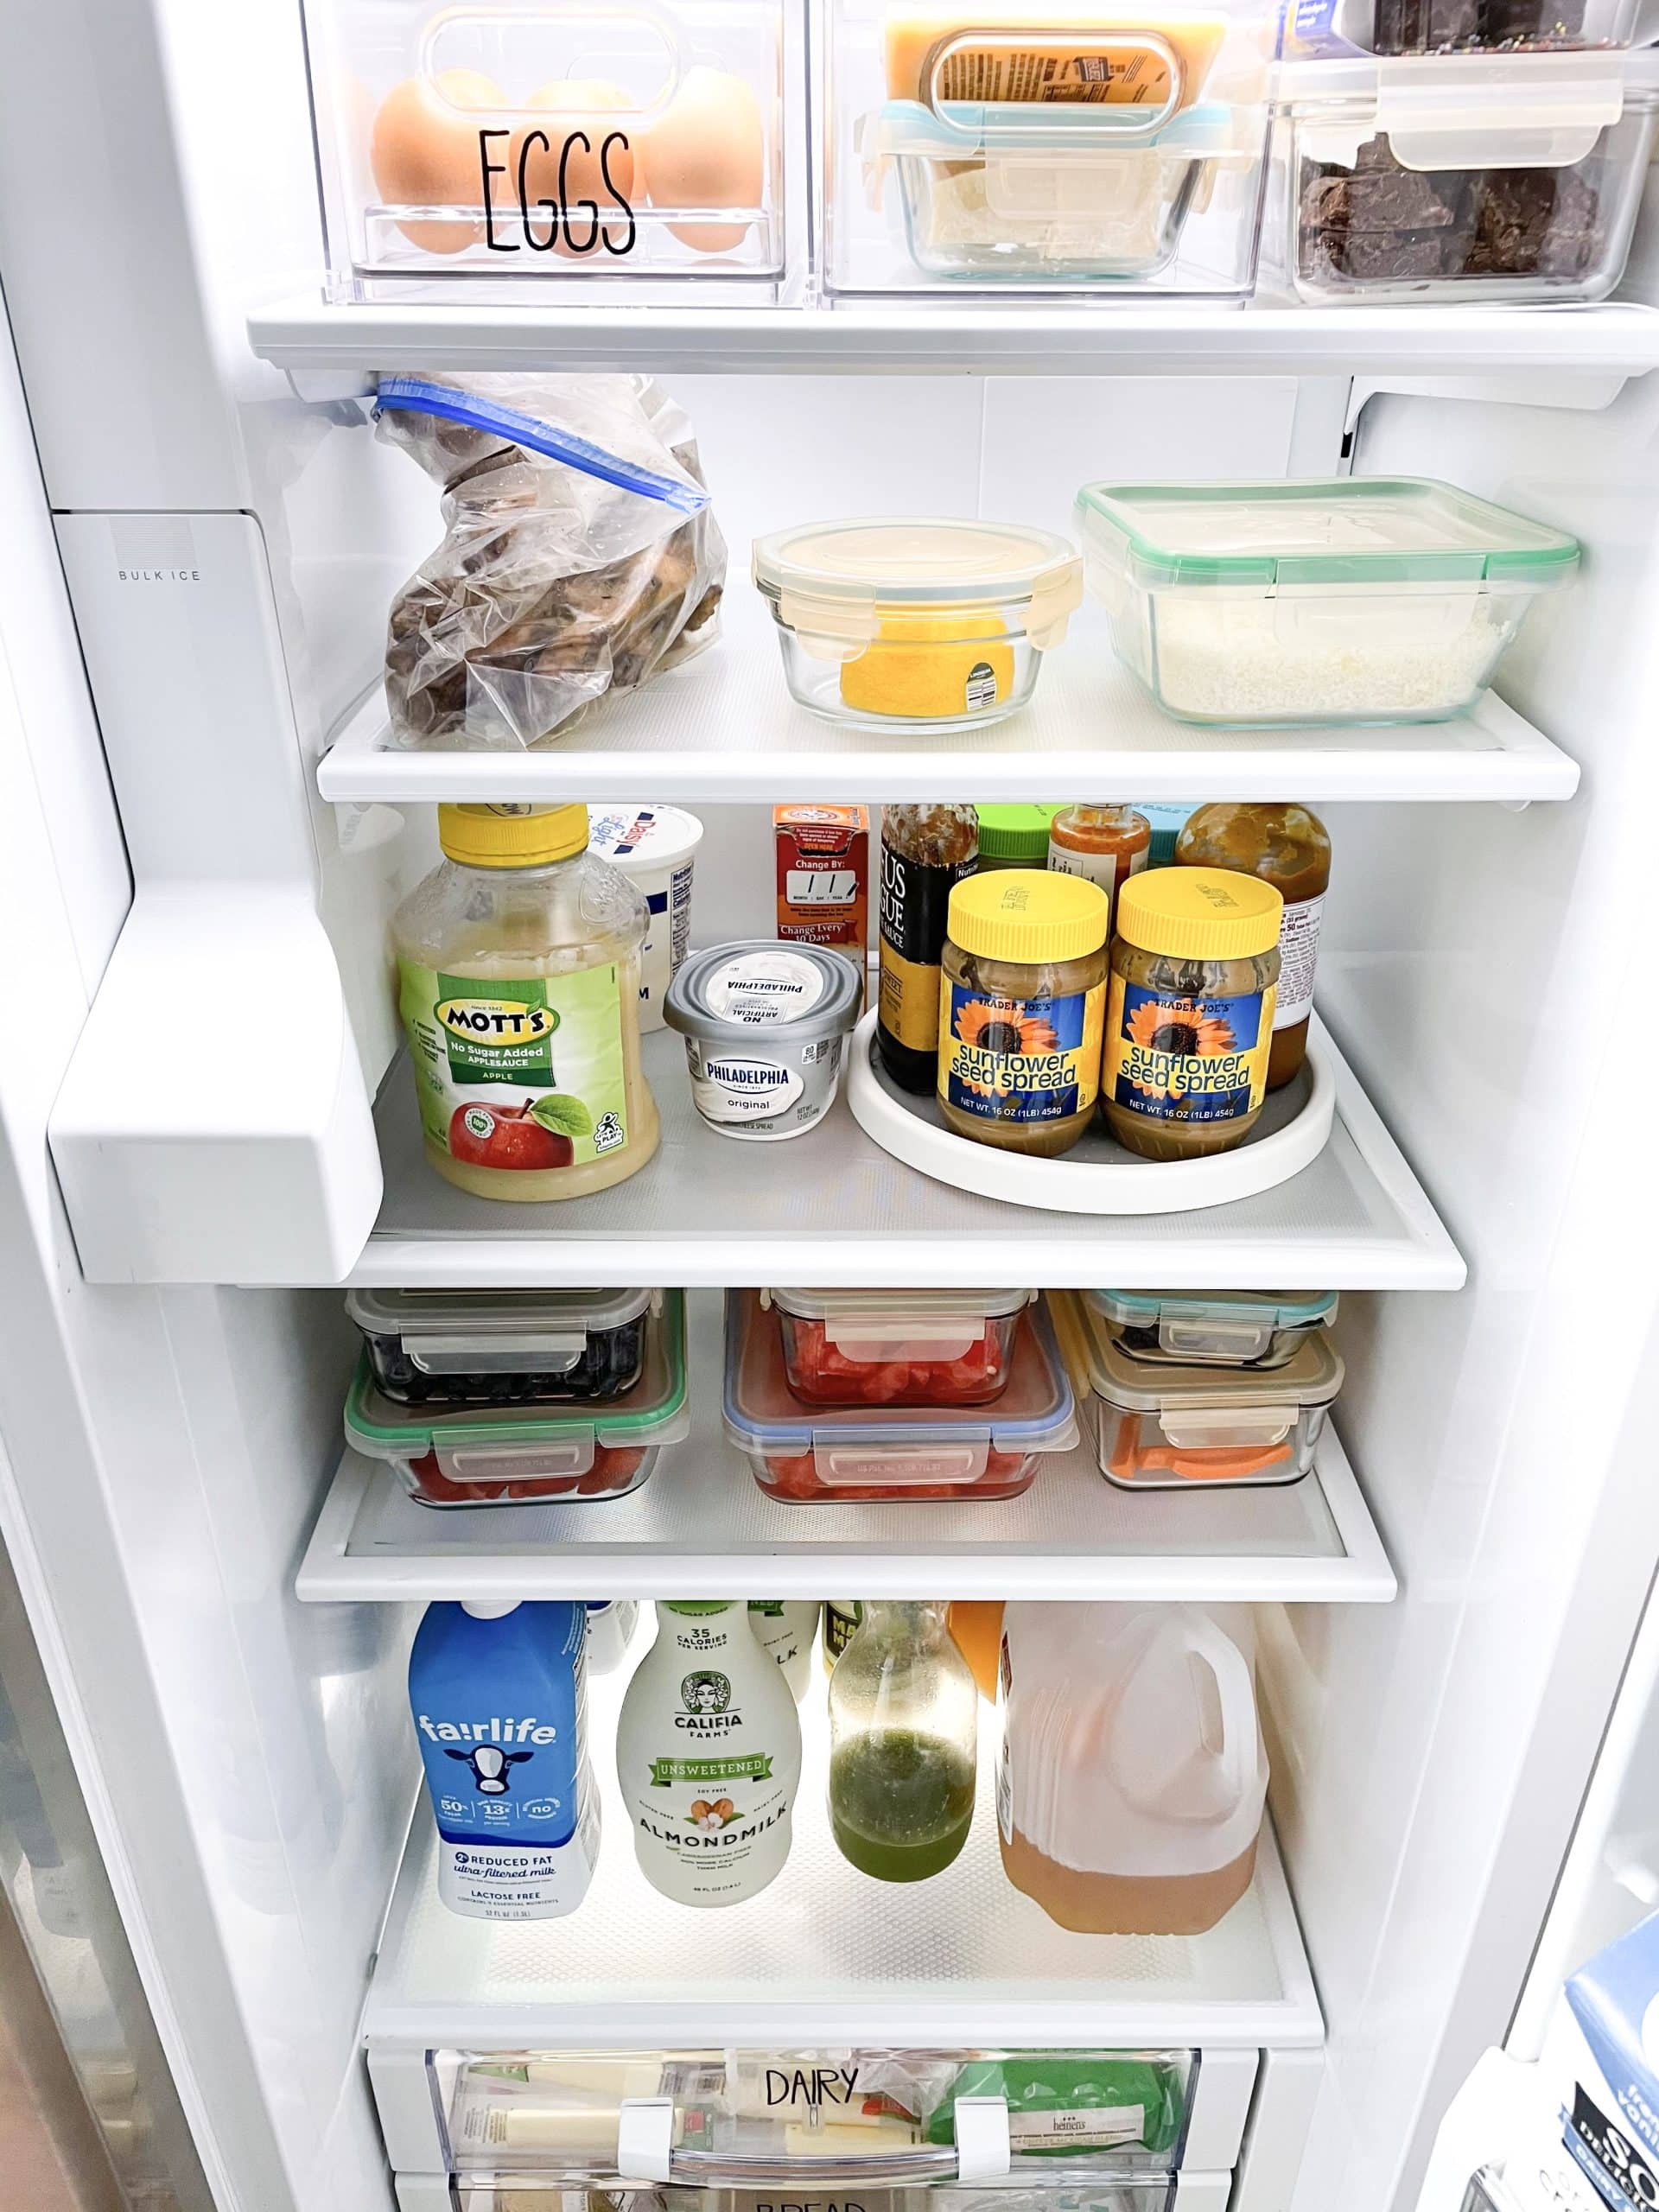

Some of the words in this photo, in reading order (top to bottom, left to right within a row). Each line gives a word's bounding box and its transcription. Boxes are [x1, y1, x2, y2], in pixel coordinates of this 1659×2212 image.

[480, 130, 636, 255] EGGS
[118, 570, 163, 581] BULK
[171, 570, 200, 581] ICE
[616, 822, 656, 846] Daisy
[795, 860, 829, 871] Change
[780, 925, 816, 936] Change
[809, 934, 830, 943] Days
[728, 981, 803, 994] PHILADELPHIA
[977, 997, 1018, 1011] TRADER
[1022, 1001, 1051, 1012] JOE'S
[1154, 998, 1197, 1012] TRADER
[1200, 1003, 1230, 1013] JOE'S
[447, 1006, 544, 1033] MOTT'S
[733, 1009, 778, 1018] ARTIFICIAL
[451, 1042, 465, 1052] No
[467, 1046, 500, 1058] Sugar
[503, 1047, 543, 1057] Added
[467, 1056, 529, 1067] APPLESAUCE
[960, 1045, 1069, 1073] sunflower
[1131, 1046, 1244, 1075] sunflower
[707, 1062, 789, 1084] PHILADELPHIA
[952, 1057, 995, 1086] seed
[1001, 1064, 1076, 1091] spread
[1122, 1059, 1168, 1088] seed
[1175, 1065, 1249, 1092] spread
[728, 1100, 770, 1109] original
[961, 1097, 975, 1108] NET
[976, 1101, 990, 1113] WT.
[1004, 1108, 1015, 1116] OZ
[1018, 1108, 1039, 1117] (1LB)
[1041, 1107, 1062, 1116] 454g
[1129, 1099, 1145, 1110] NET
[1147, 1103, 1162, 1115] WT.
[1176, 1110, 1189, 1119] OZ
[1191, 1110, 1212, 1119] (1LB)
[1215, 1108, 1234, 1117] 454g
[677, 1633, 728, 1645] CALORIES
[691, 1628, 710, 1638] 35
[674, 1714, 742, 1729] CALIFIA
[690, 1730, 728, 1738] FARMS
[660, 1760, 762, 1776] UNSWEETENED
[532, 1805, 551, 1814] no
[640, 1802, 787, 1847] ALMONDMILK
[471, 1855, 529, 1866] REDUCED
[533, 1856, 553, 1866] FAT
[454, 1865, 528, 1878] ultra-filtered
[530, 1867, 556, 1877] milk
[471, 1890, 513, 1900] LACTOSE
[766, 2068, 859, 2105] DAIRY
